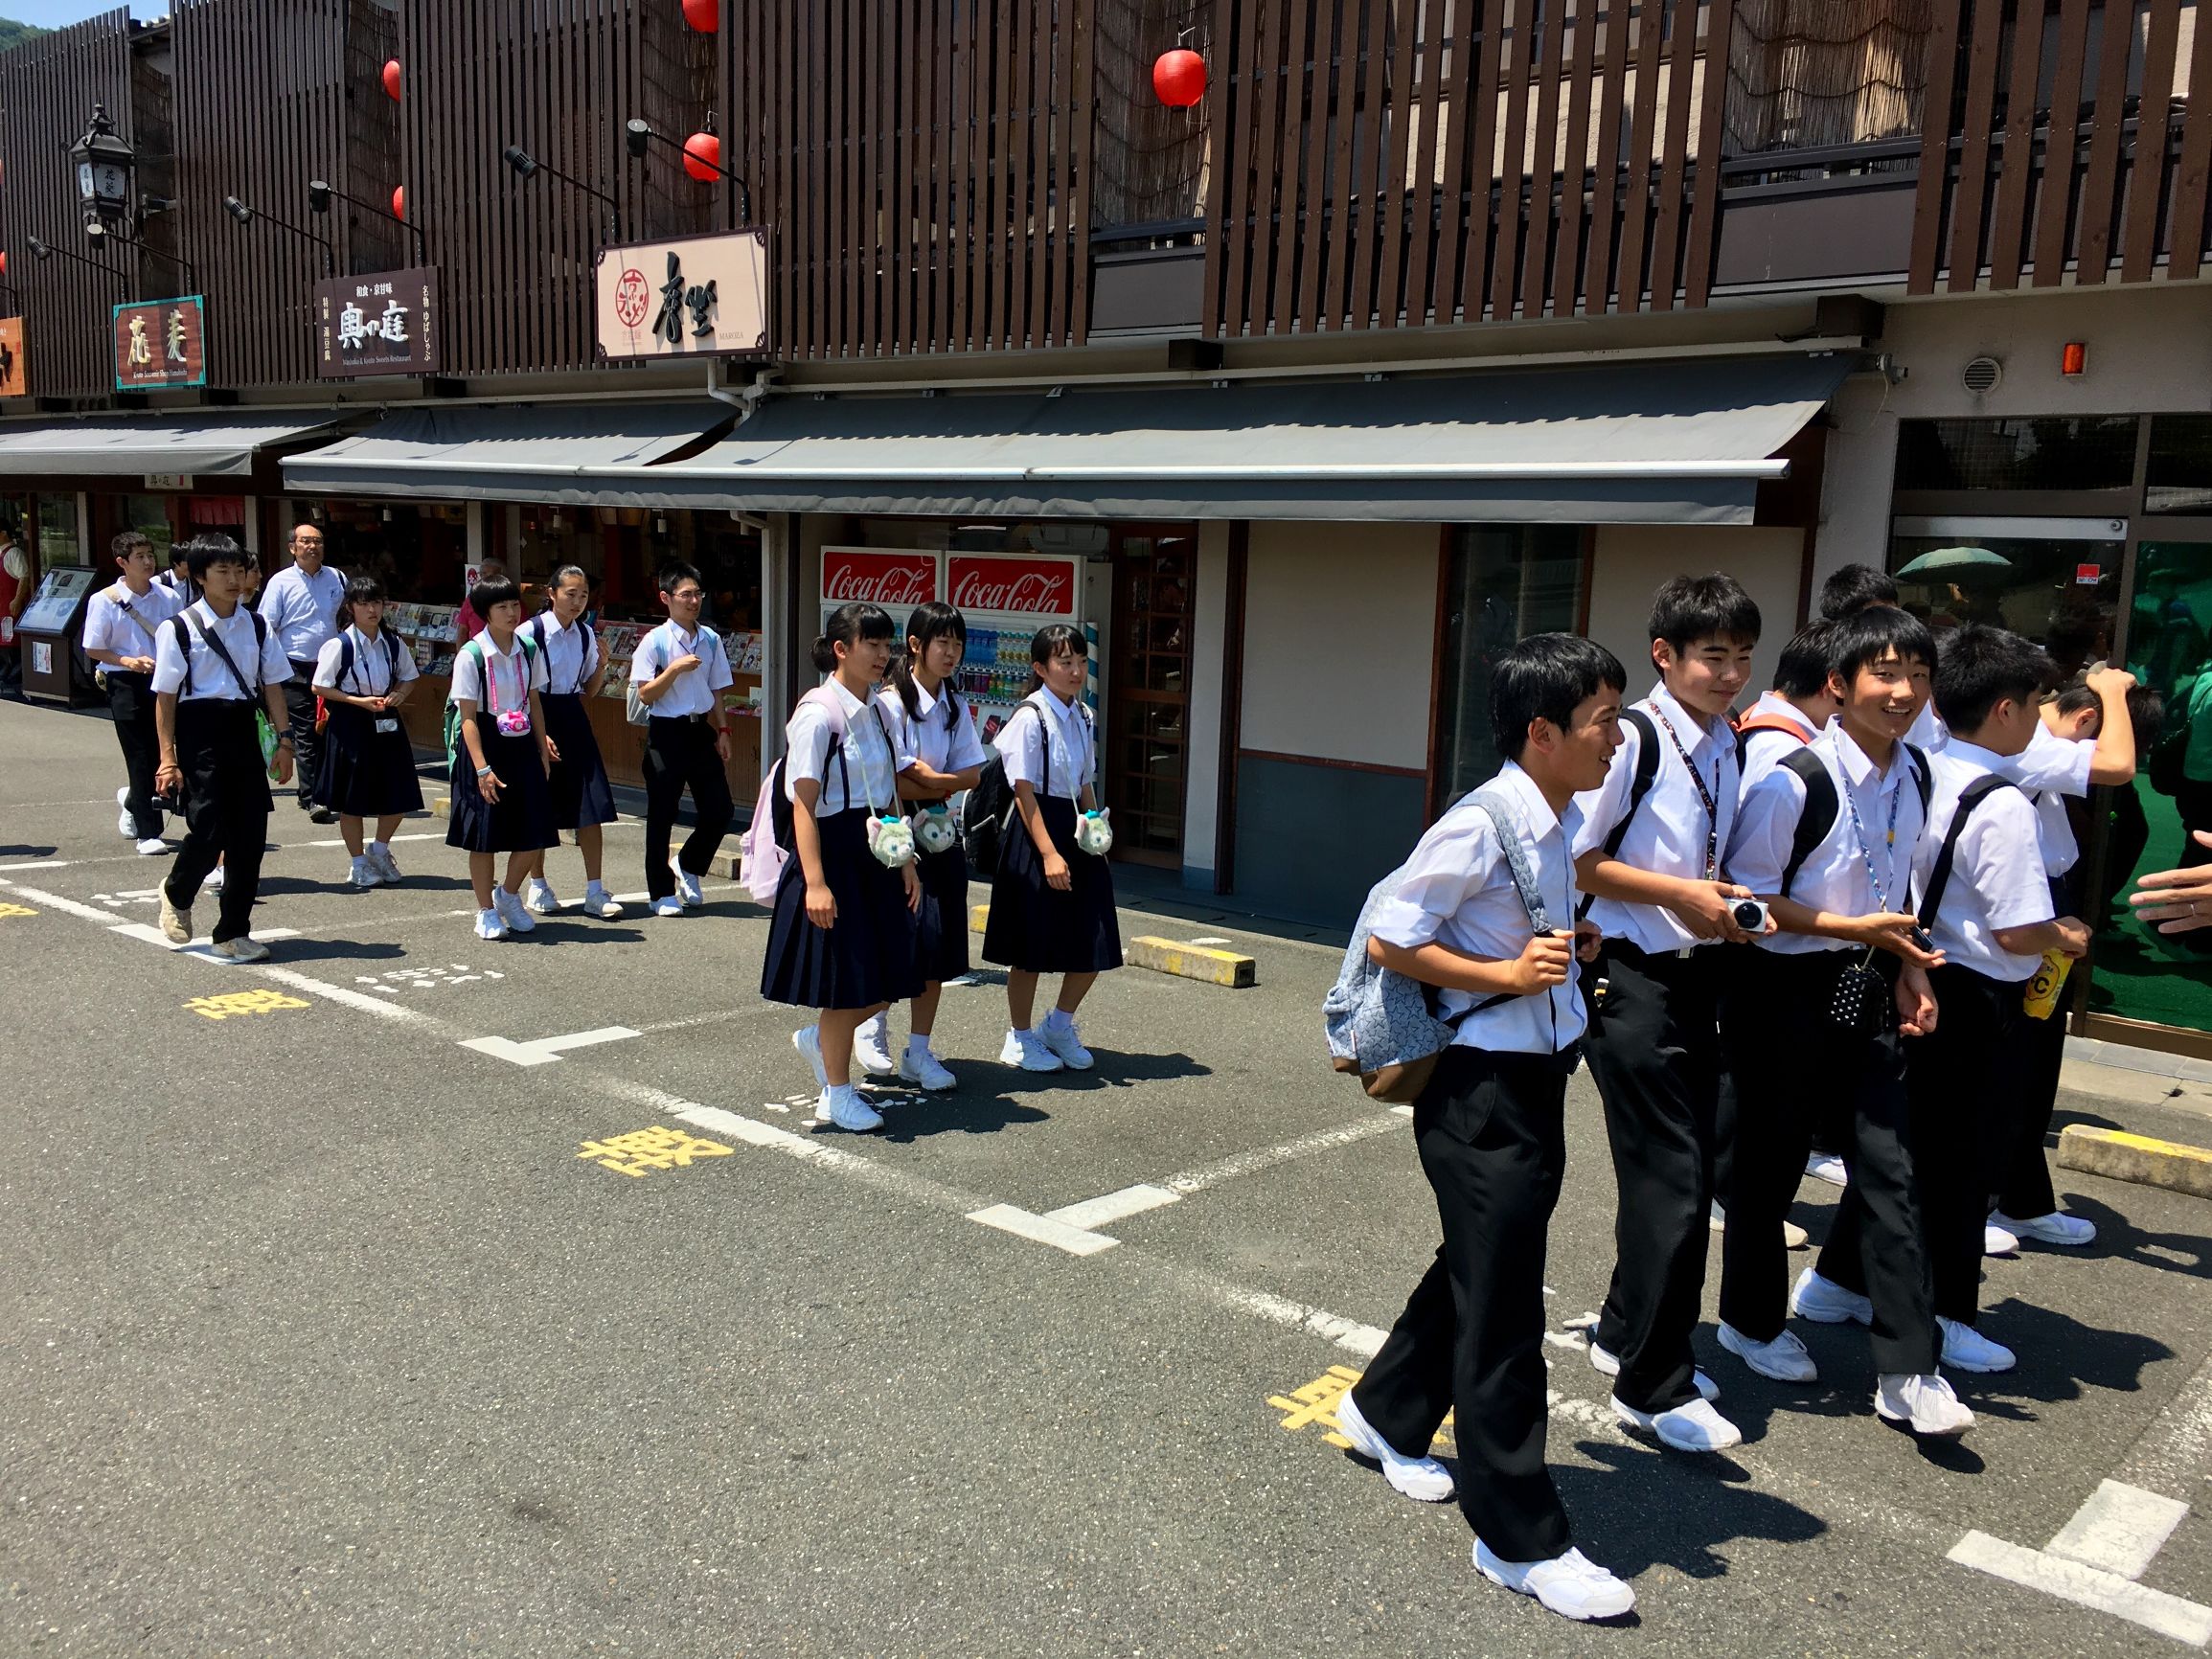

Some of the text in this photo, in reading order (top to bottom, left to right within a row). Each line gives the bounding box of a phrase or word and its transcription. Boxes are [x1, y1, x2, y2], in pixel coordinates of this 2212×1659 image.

[356, 283, 393, 297] 和食・京甘味
[323, 327, 331, 361] 湯豆腐
[159, 369, 169, 378] Shop
